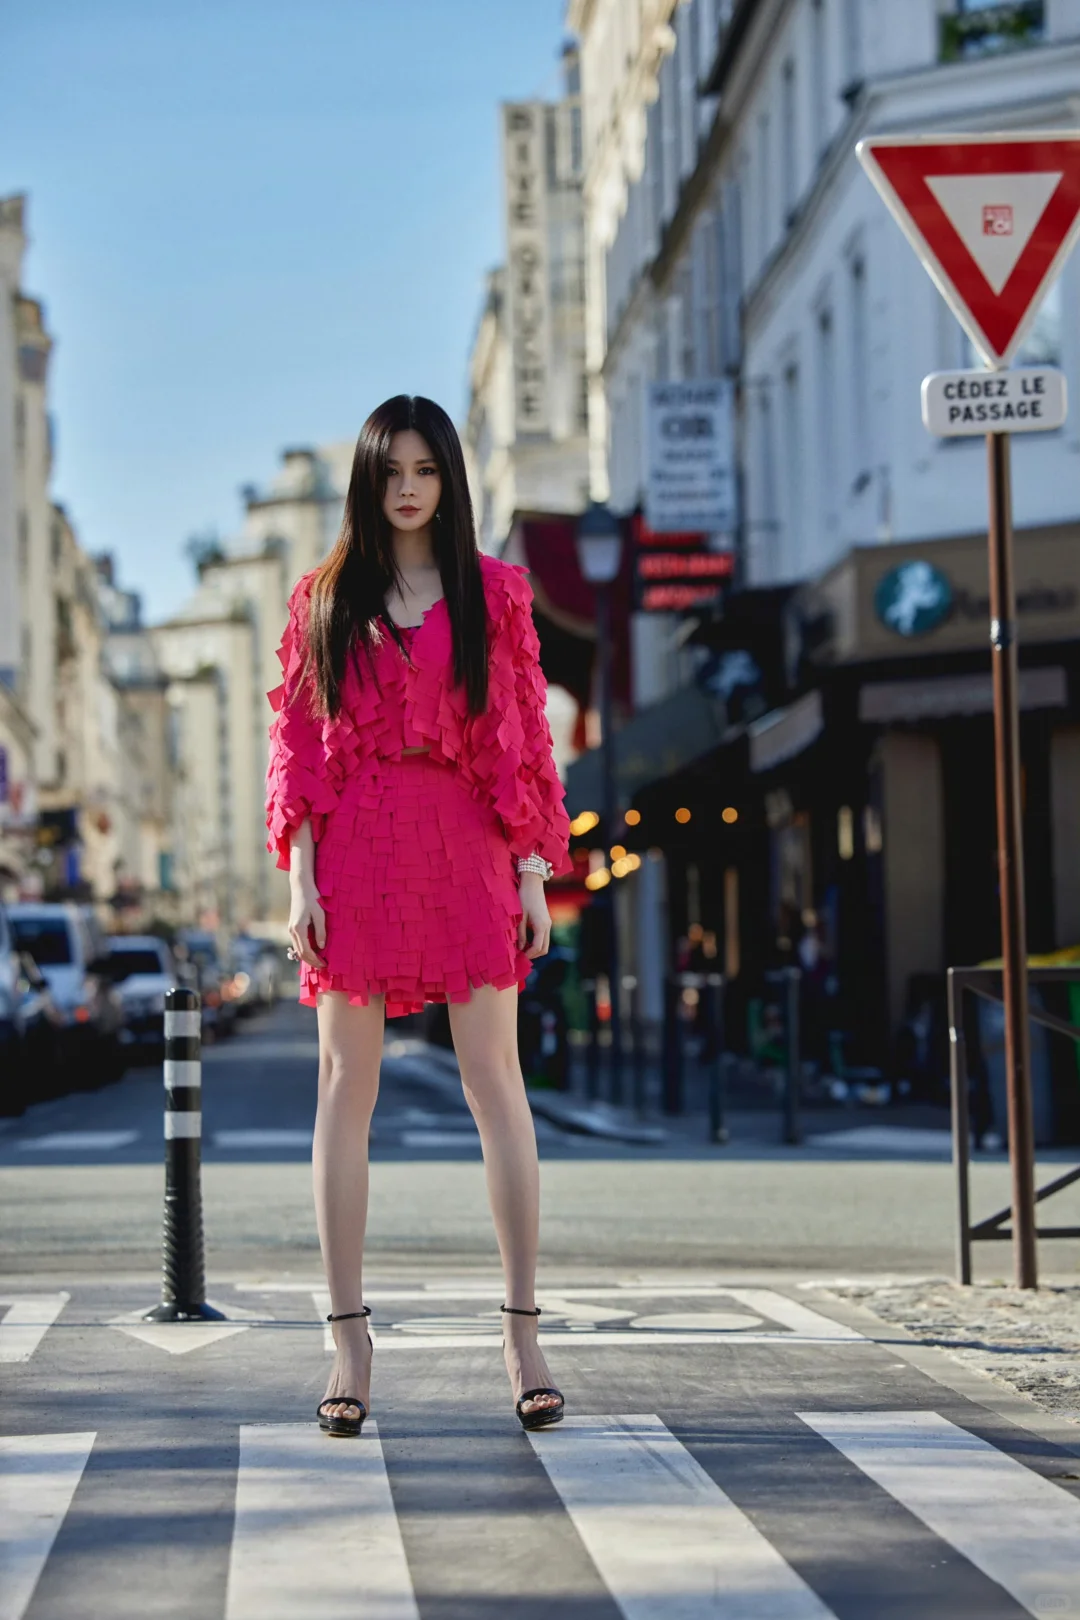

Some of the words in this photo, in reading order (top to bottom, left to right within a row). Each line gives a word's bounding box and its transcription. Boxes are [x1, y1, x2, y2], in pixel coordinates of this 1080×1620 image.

[944, 378, 1008, 399] CÉDEZ
[1021, 376, 1045, 395] LE
[949, 400, 1042, 424] PASSAGE
